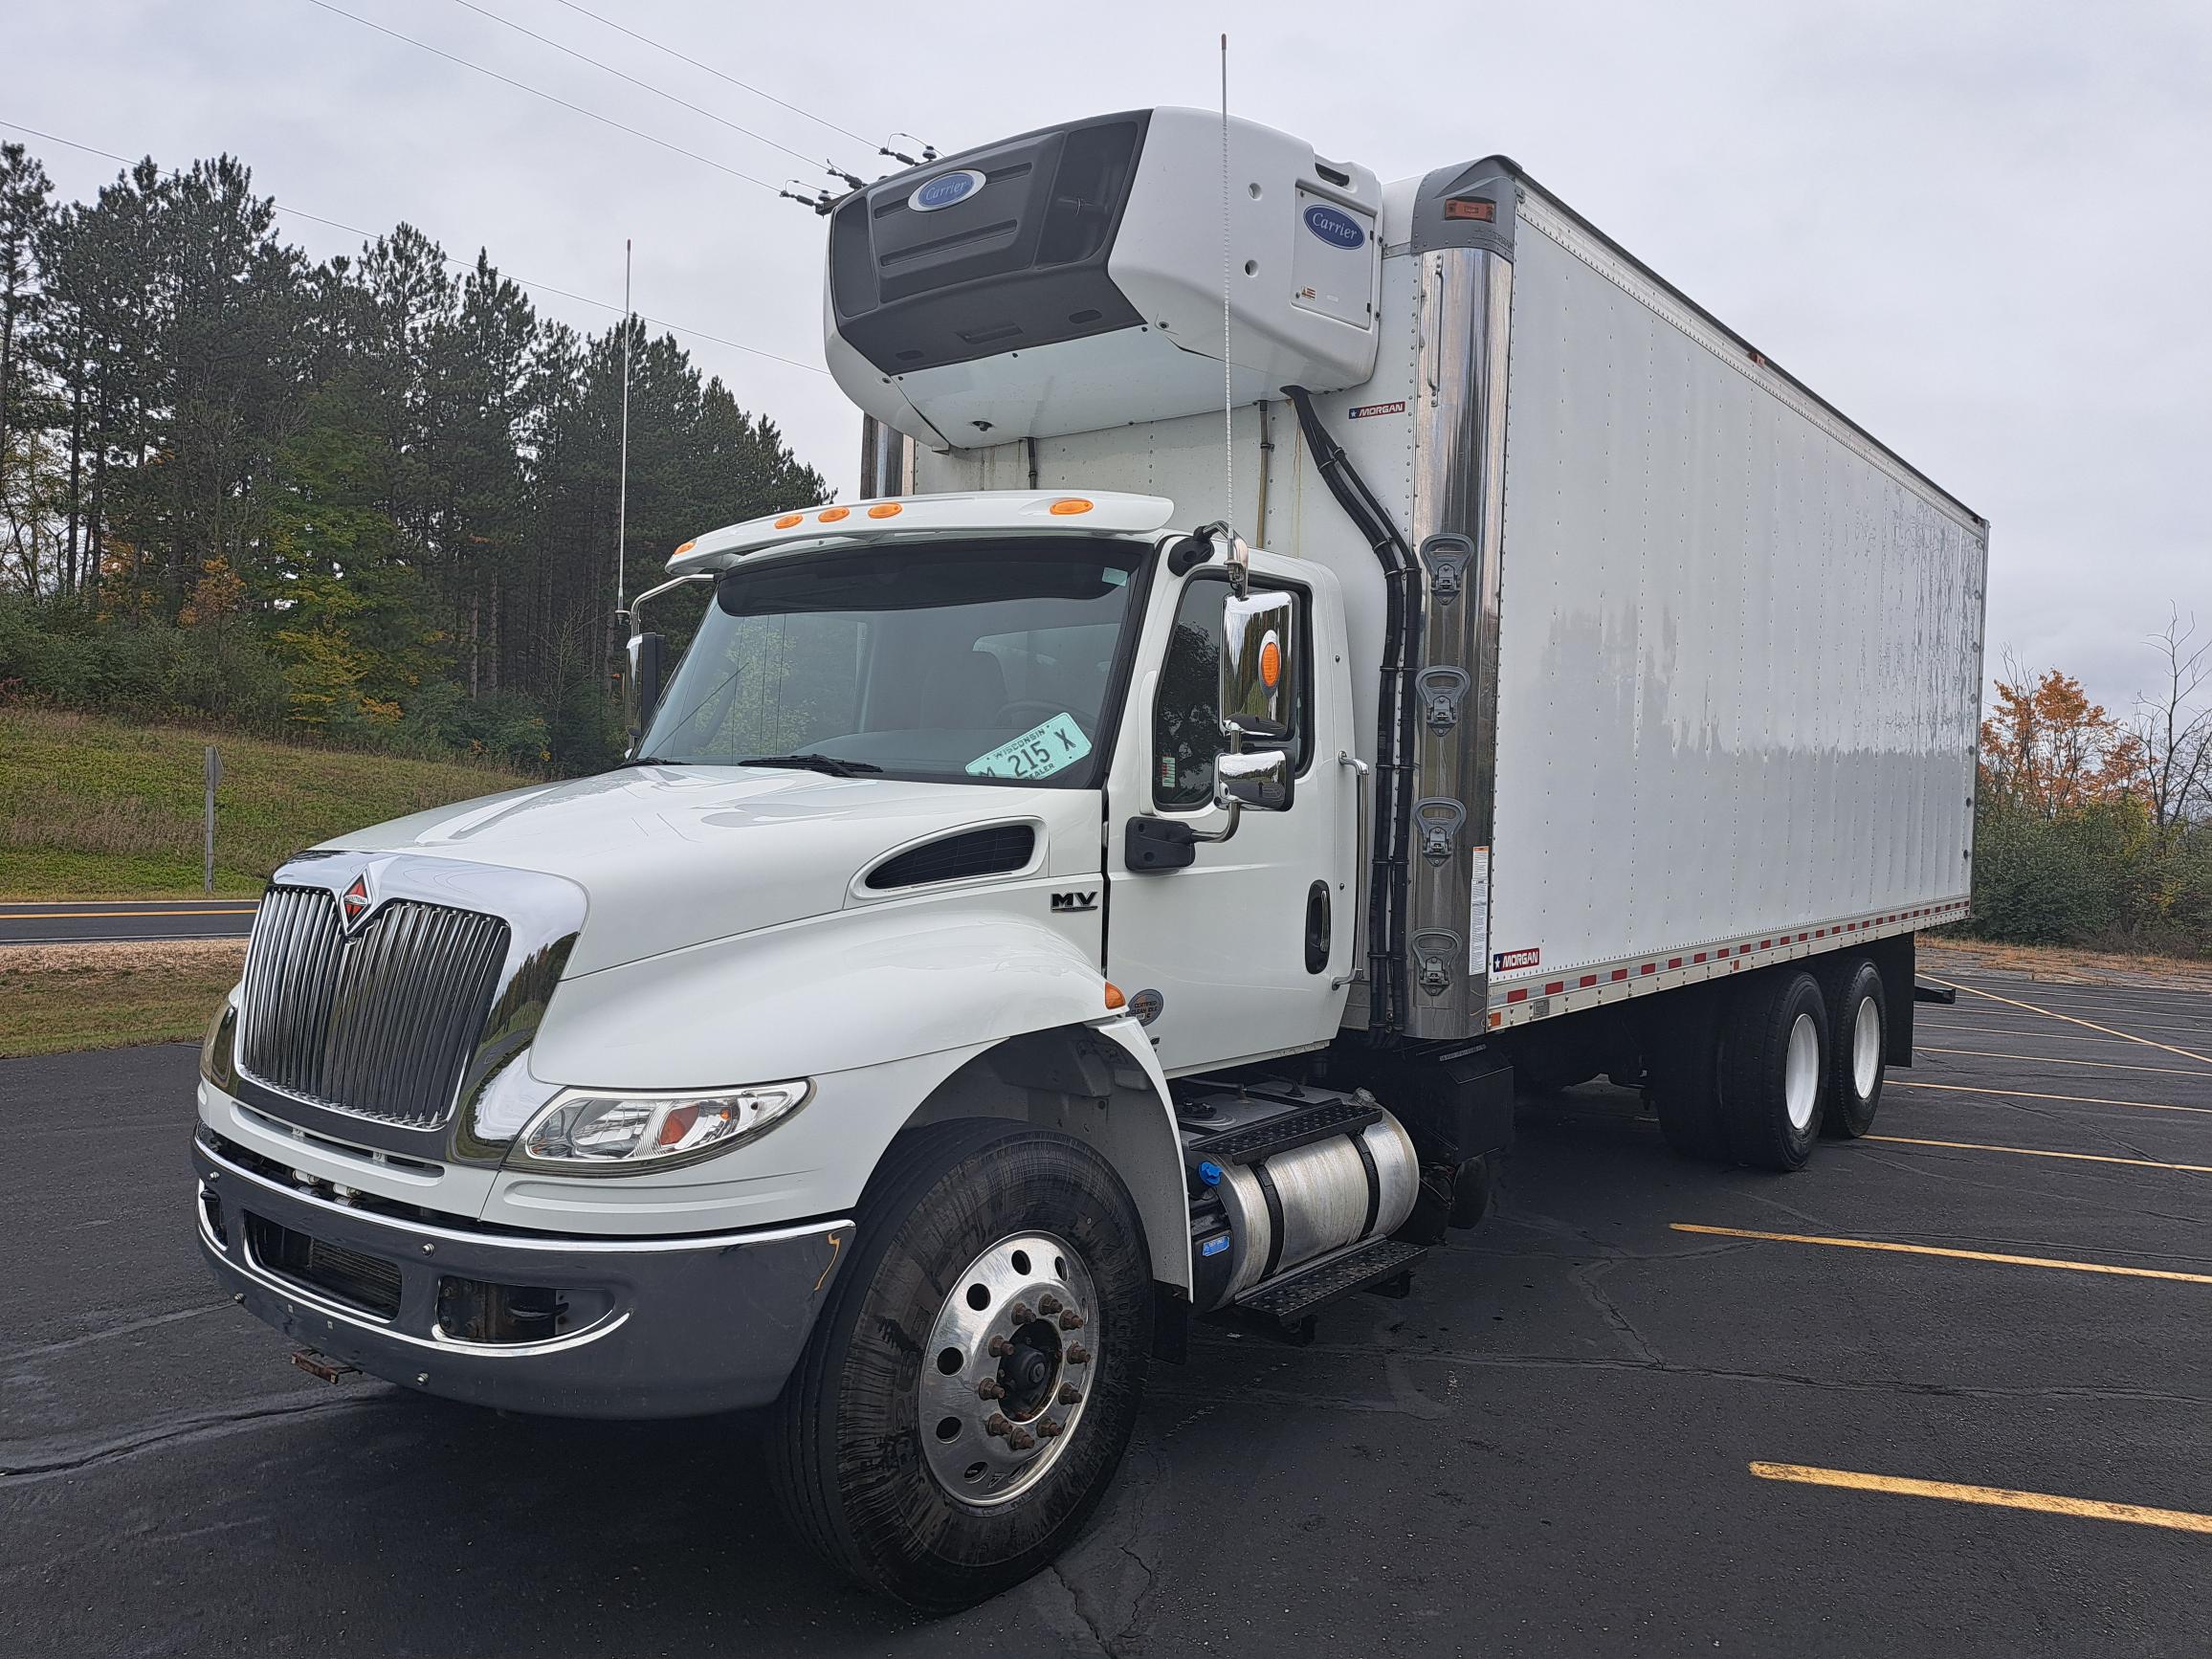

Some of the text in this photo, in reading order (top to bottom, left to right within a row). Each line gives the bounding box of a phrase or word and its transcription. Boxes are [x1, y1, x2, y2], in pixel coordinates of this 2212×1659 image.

[925, 180, 967, 201] Carrier
[1312, 212, 1358, 240] Carrier
[1359, 403, 1405, 417] MORGAN
[993, 728, 1046, 761] WISCONSIN
[1007, 741, 1051, 777] 215
[1053, 727, 1077, 752] X
[1051, 891, 1098, 908] MV
[1502, 951, 1538, 968] MORGAN
